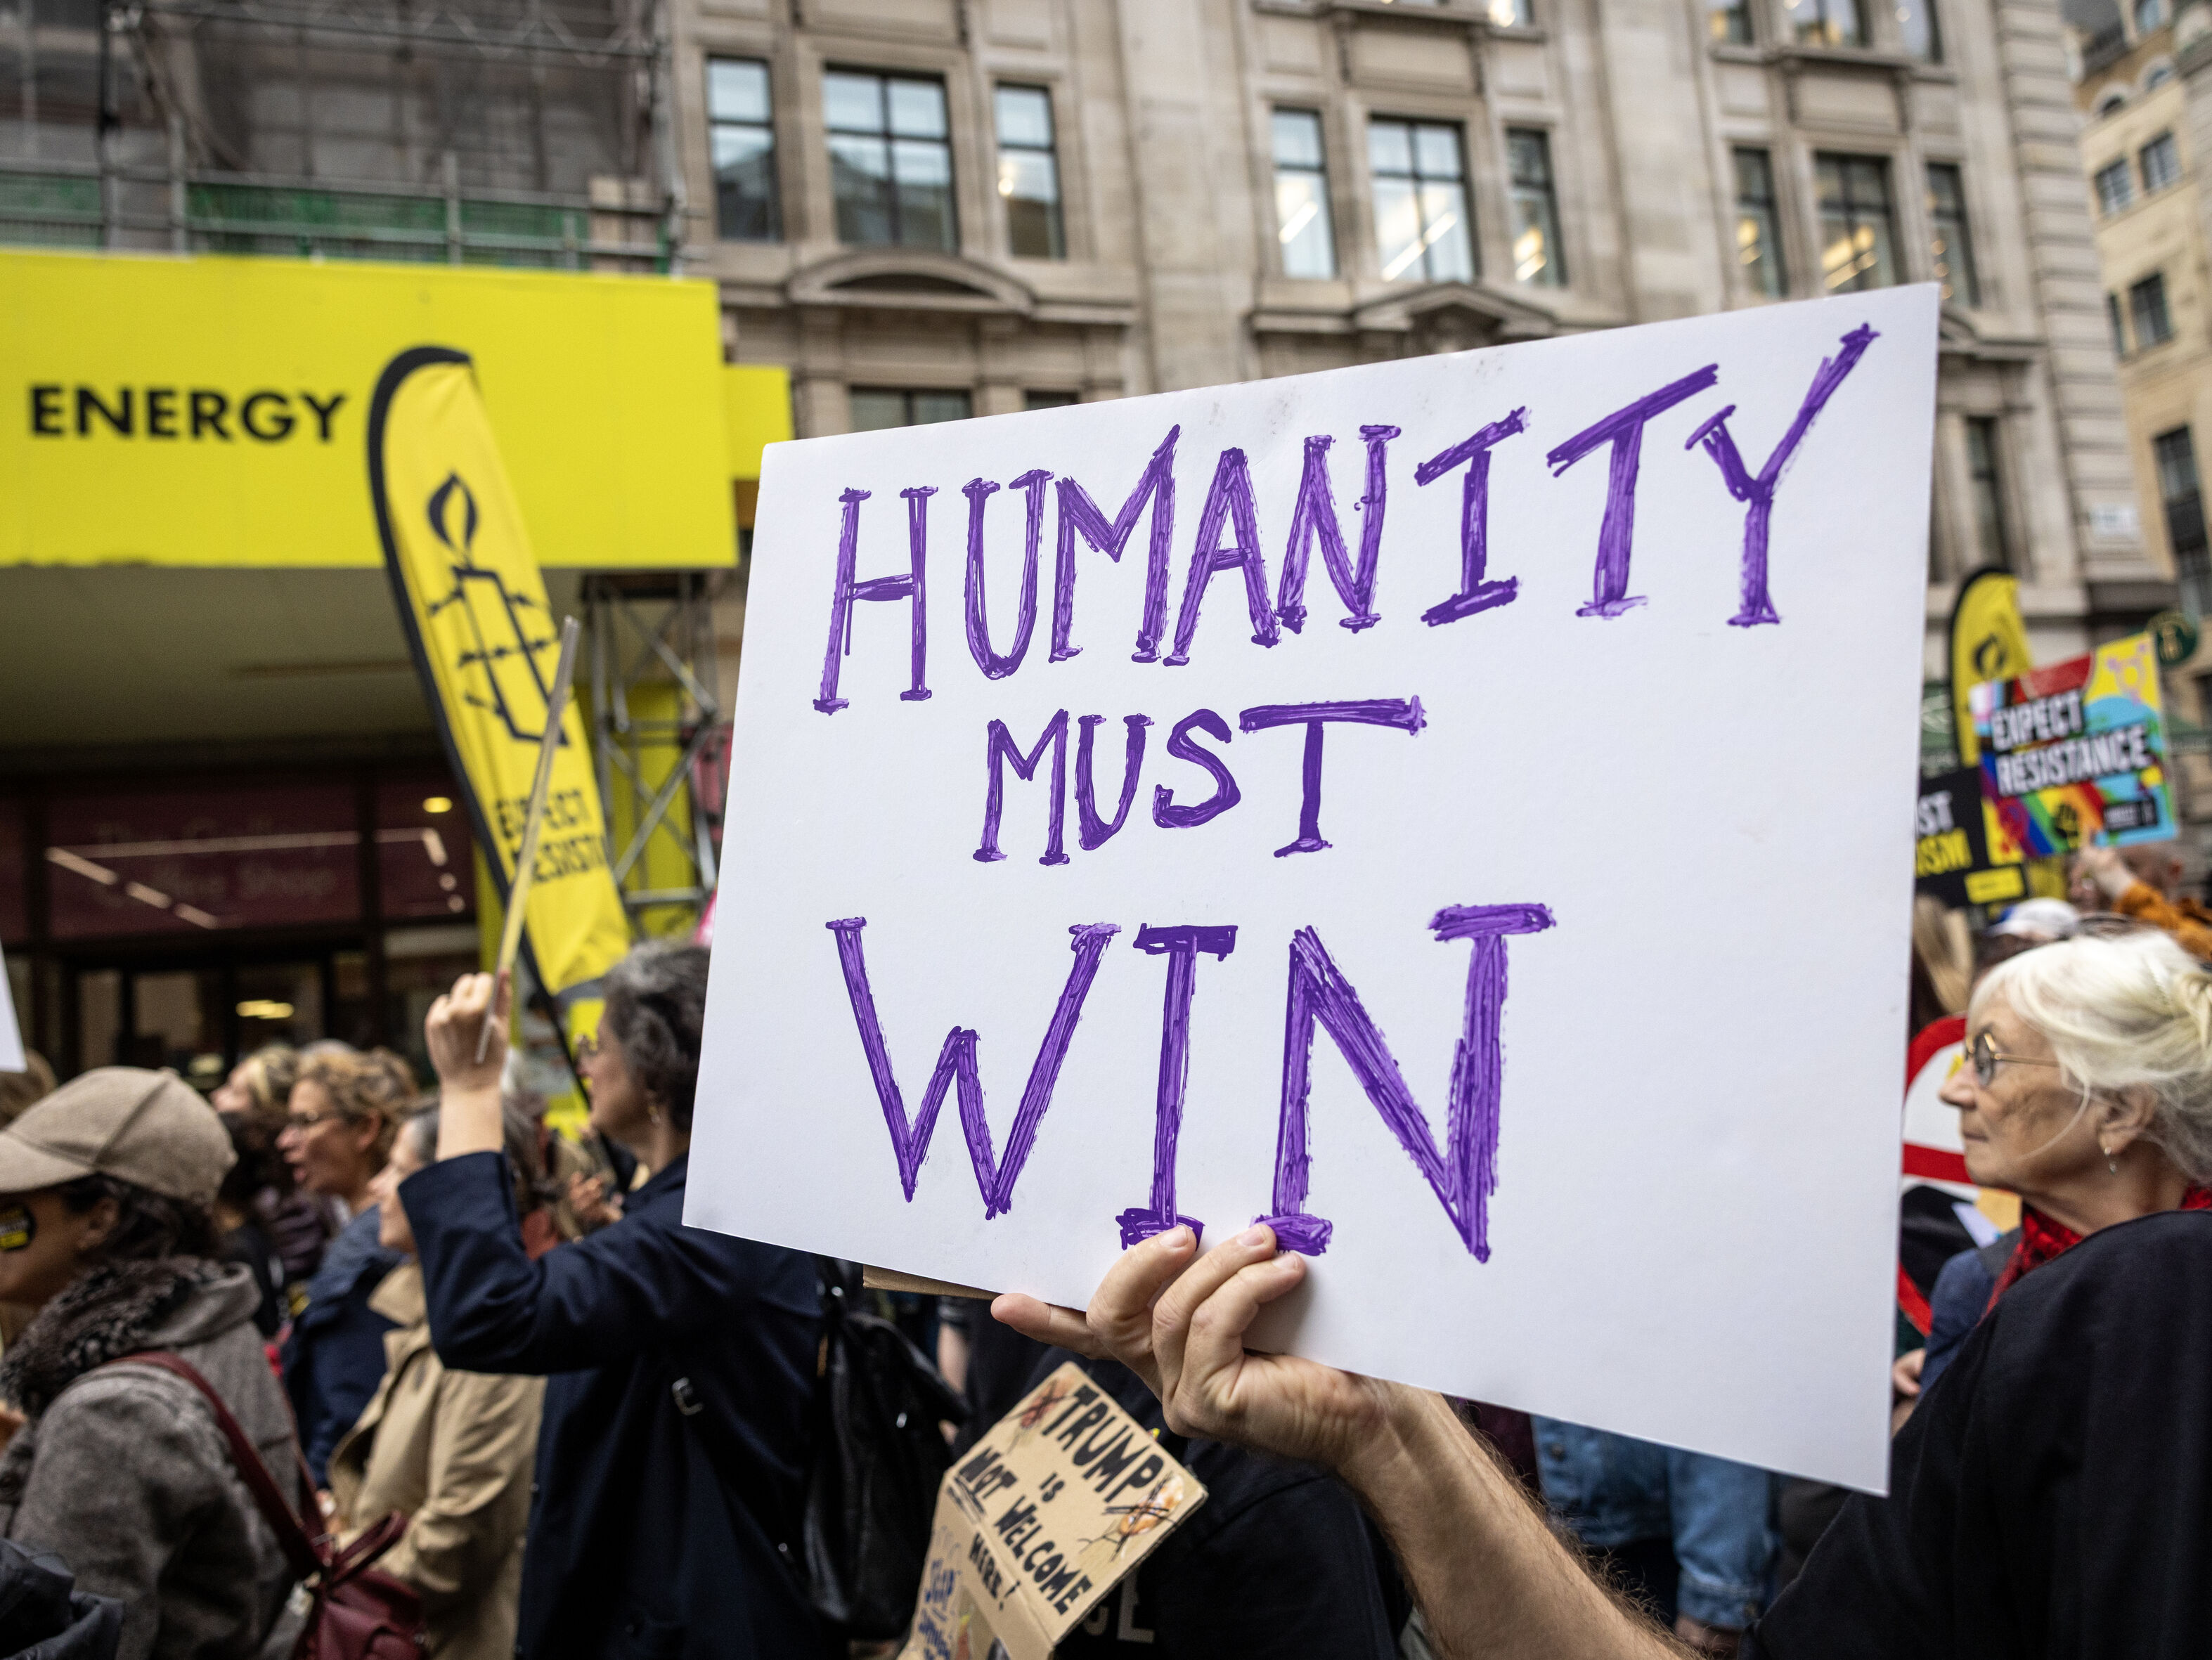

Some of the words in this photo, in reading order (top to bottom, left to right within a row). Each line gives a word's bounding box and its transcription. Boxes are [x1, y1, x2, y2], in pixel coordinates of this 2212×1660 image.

[30, 383, 349, 443] ENERGY
[813, 323, 1880, 715] HUMANITY
[1991, 689, 2082, 751] EXPECT
[1997, 724, 2152, 796] RESISTANCE
[496, 788, 593, 836] EXECT
[973, 696, 1427, 866] MUST
[826, 904, 1556, 1263] WIN
[1042, 1385, 1164, 1503] TRUMP
[1040, 1472, 1064, 1503] IS
[959, 1446, 1017, 1501] NOT
[993, 1495, 1094, 1616] WELCOME
[969, 1531, 1021, 1611] HERE!
